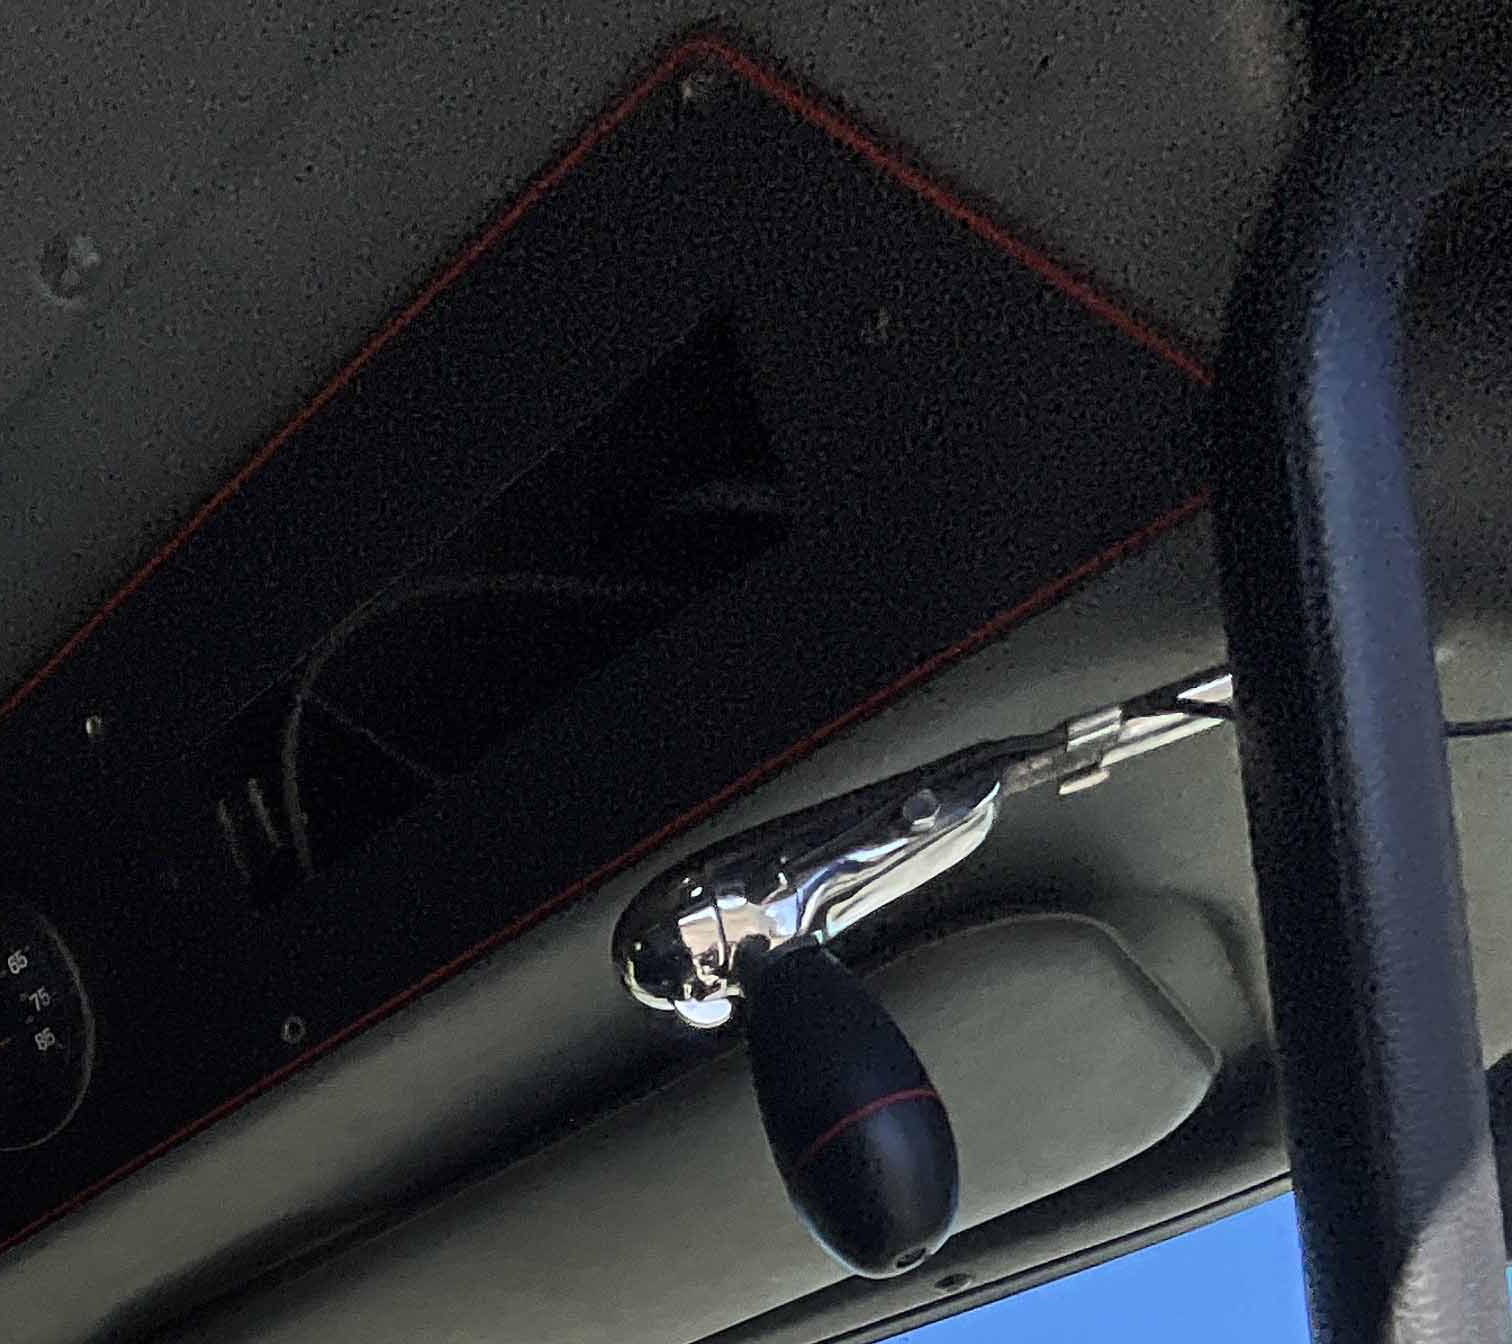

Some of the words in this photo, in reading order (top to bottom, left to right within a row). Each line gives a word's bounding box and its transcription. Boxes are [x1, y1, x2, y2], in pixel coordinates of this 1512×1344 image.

[7, 950, 28, 975] 65
[28, 986, 51, 1012] 75
[34, 1027, 56, 1051] 85
